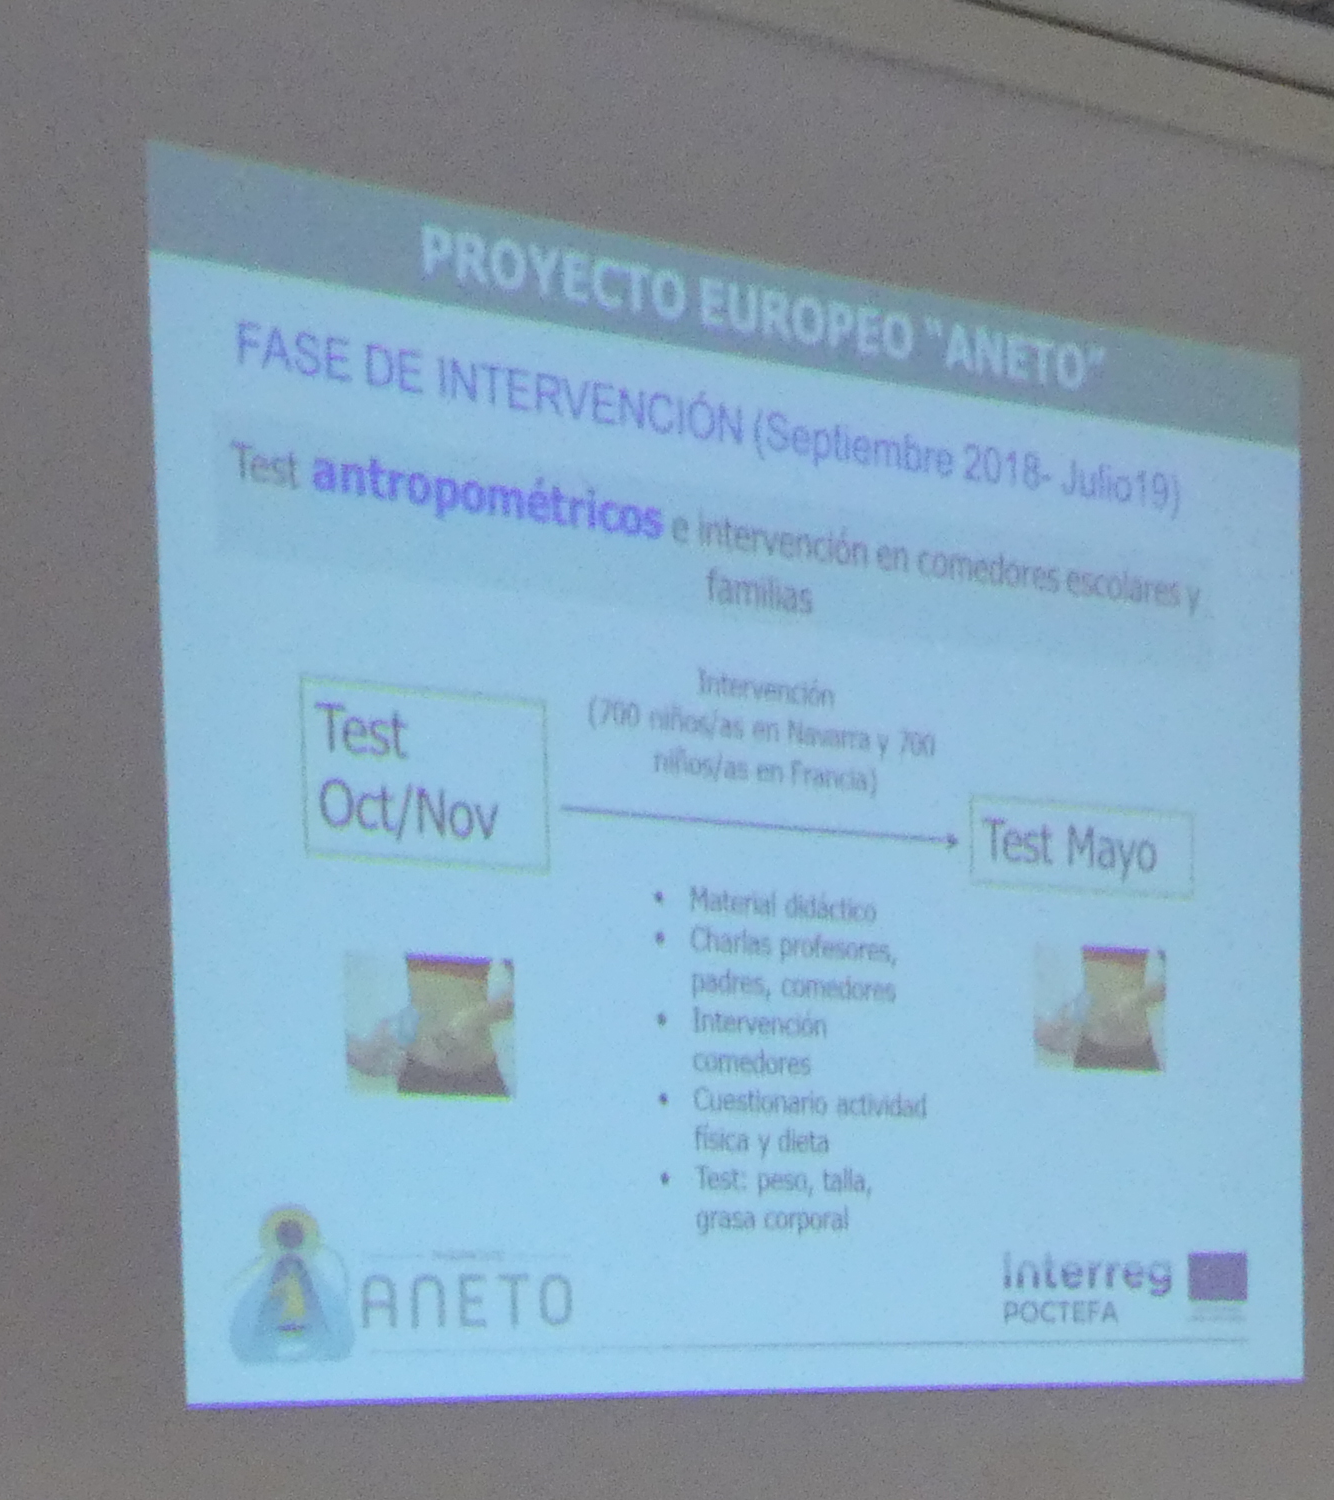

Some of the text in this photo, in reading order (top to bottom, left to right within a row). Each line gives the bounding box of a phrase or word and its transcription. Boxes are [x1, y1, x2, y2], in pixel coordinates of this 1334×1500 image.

[420, 222, 1106, 391] PROYECTO EUROPEO "ANETO"
[235, 321, 353, 384] FASE
[366, 343, 425, 395] DE
[438, 357, 744, 446] INTERVENCIÓN
[754, 408, 954, 479] (Septiembre
[1060, 459, 1182, 521] Julio19)
[230, 439, 1202, 617] Test antropométricos e intervención en comedores escolares y
[706, 567, 815, 616] familias
[697, 666, 836, 709] Intervención
[314, 700, 408, 761] Test
[752, 718, 780, 744] en
[788, 719, 872, 752] Navarra
[757, 760, 785, 784] en
[319, 776, 499, 842] Oct/Nov
[981, 815, 1159, 884] Test Mayo
[689, 884, 777, 918] Material
[689, 924, 898, 968] Charlas profesores,
[691, 967, 898, 1003] padres, comedores
[693, 1005, 828, 1039] Intervención
[692, 1047, 812, 1077] comedores
[694, 1085, 928, 1120] Cuestionario actividad
[758, 1133, 771, 1160] y
[778, 1126, 831, 1154] dieta
[758, 1169, 814, 1198] peso,
[823, 1166, 872, 1198] talla,
[696, 1204, 850, 1237] grasa corporal
[1003, 1300, 1120, 1325] POCTEFA
